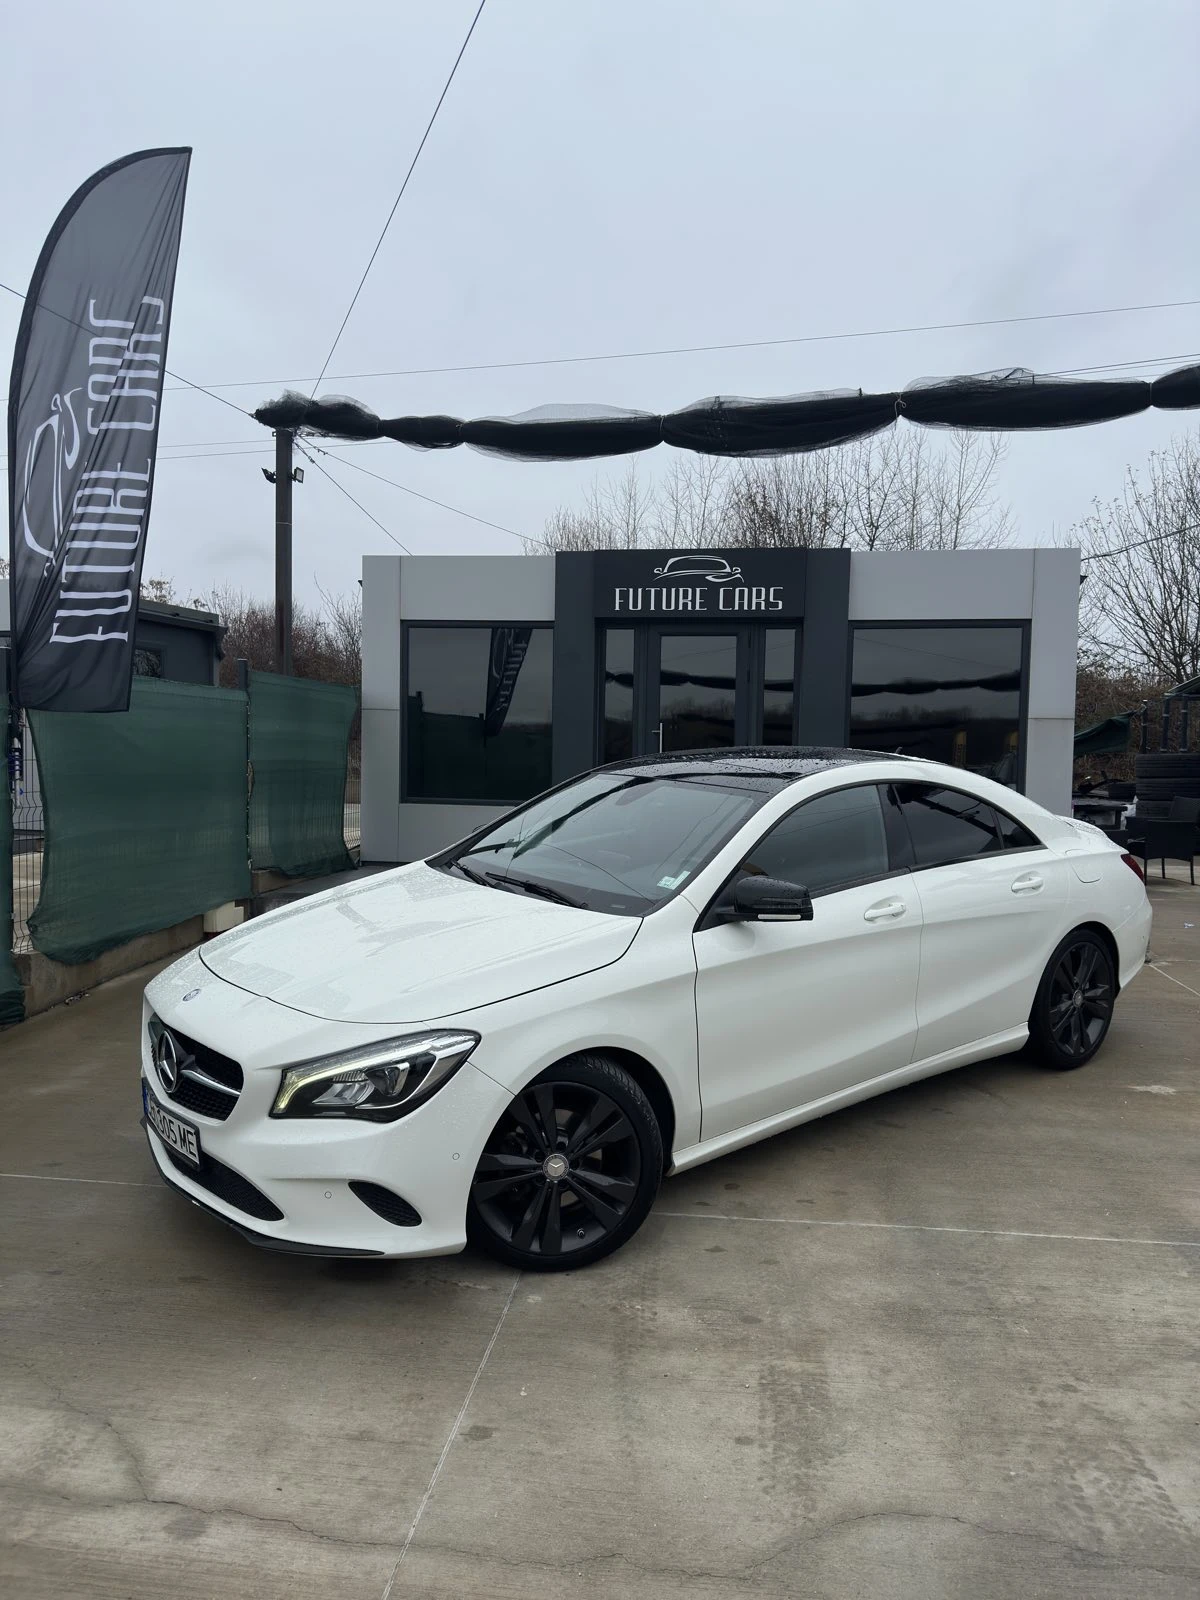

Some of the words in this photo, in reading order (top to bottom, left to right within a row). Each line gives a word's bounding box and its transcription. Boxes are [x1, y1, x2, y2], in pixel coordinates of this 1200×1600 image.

[87, 296, 165, 435] CARS
[50, 457, 151, 645] FUTURE
[613, 587, 708, 611] FUTURE
[718, 586, 784, 611] CARS
